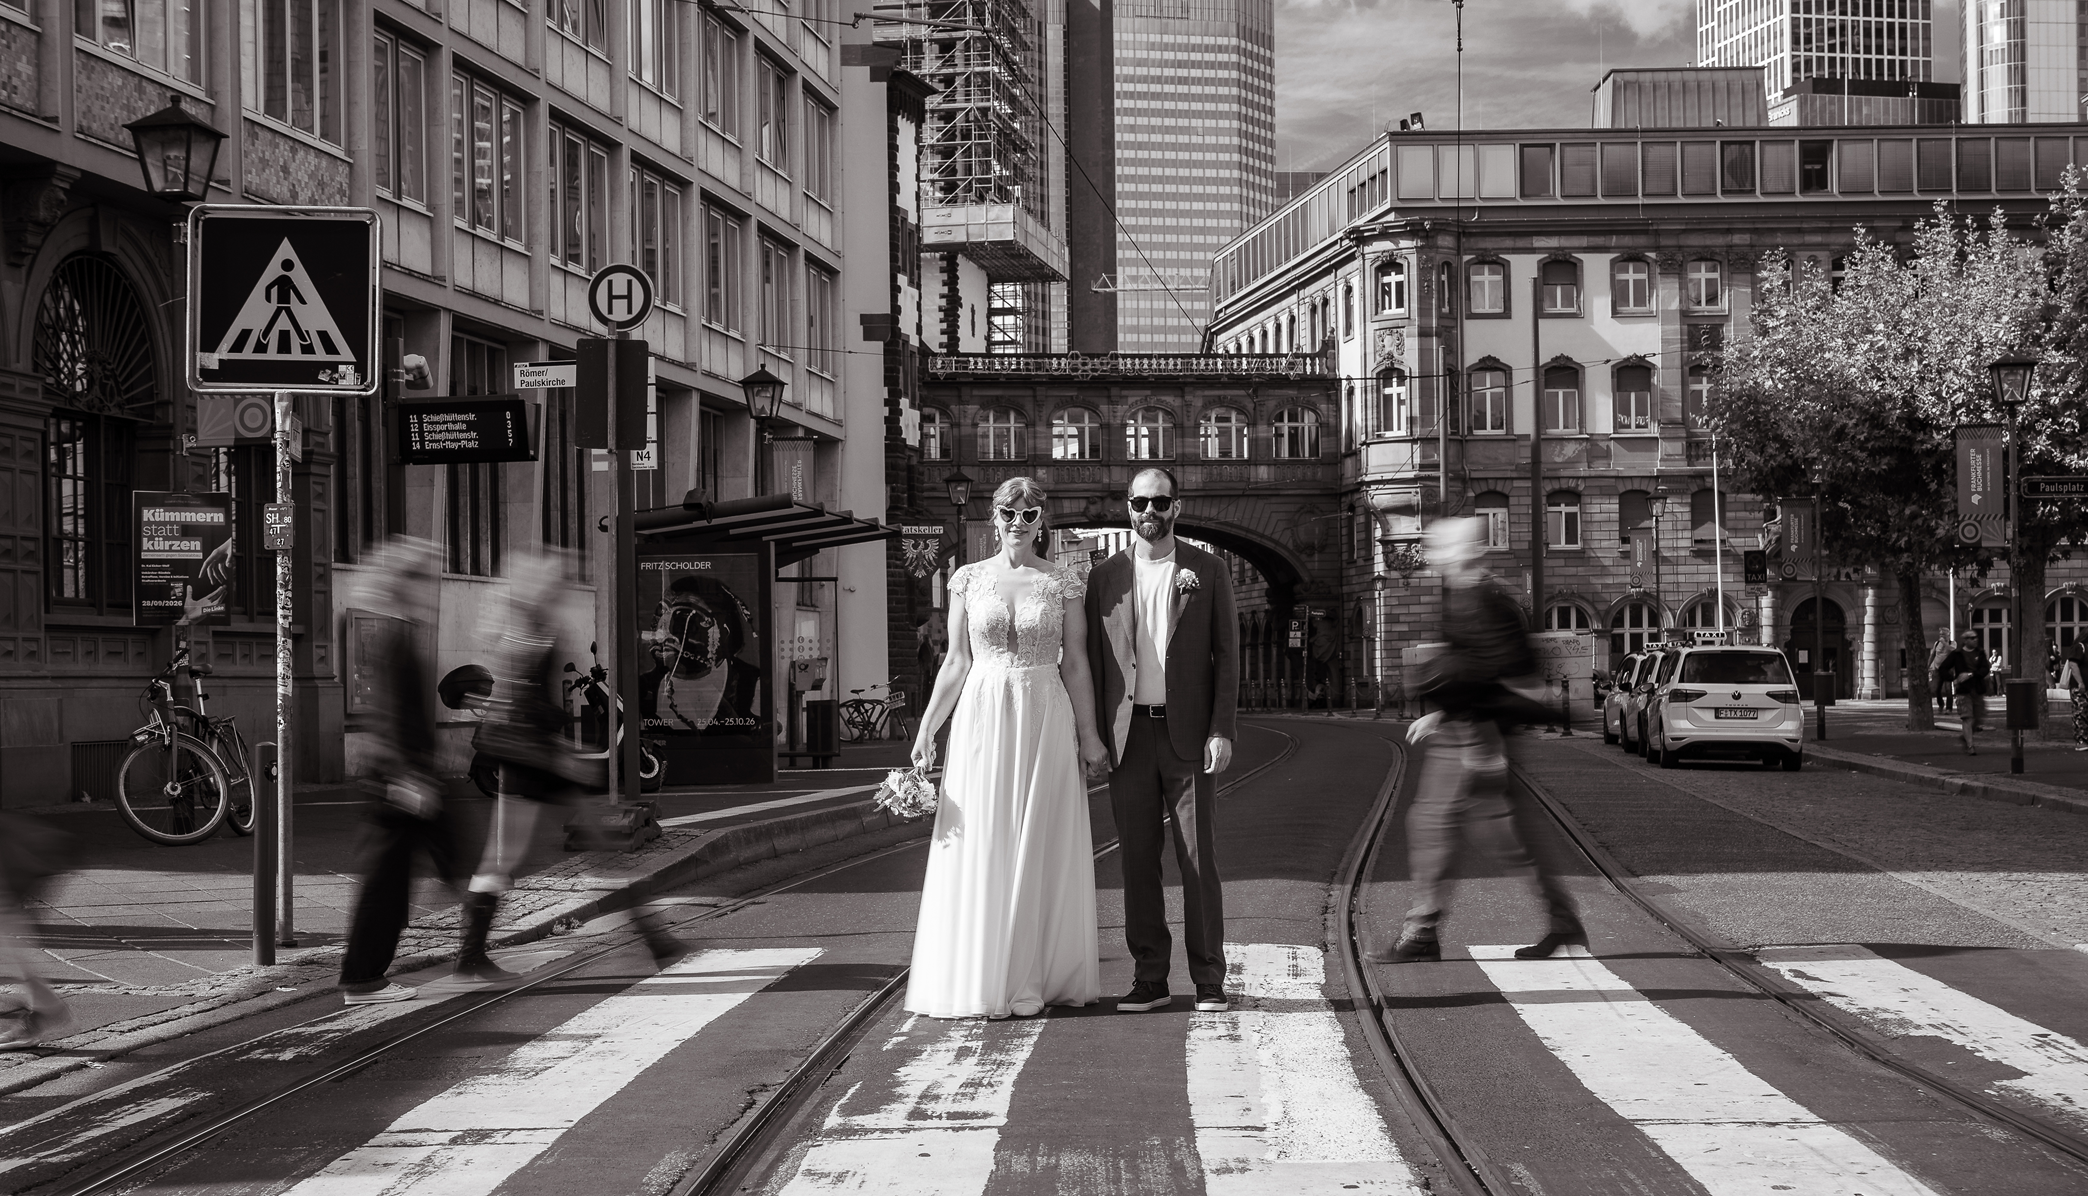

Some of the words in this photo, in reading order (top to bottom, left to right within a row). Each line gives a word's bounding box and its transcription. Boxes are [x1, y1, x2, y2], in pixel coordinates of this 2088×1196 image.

[608, 278, 635, 315] H
[520, 368, 549, 378] Römer/
[520, 378, 566, 388] Paulskirche
[409, 414, 418, 423] 11
[505, 411, 511, 419] 0
[410, 423, 419, 432] 12
[423, 422, 467, 433] Eissporthalle
[506, 420, 512, 429] 3
[411, 432, 420, 441] 11
[507, 429, 513, 438] 5
[412, 441, 421, 450] 14
[425, 440, 479, 450] Ernst-May-Platz
[508, 438, 514, 447] 7
[636, 451, 652, 461] N4
[2040, 482, 2085, 494] Paulsplatz
[143, 509, 224, 522] Kümmern
[266, 513, 279, 524] SH
[143, 524, 180, 536] statt
[902, 526, 943, 534] atskeller
[143, 537, 201, 551] kürzen
[640, 562, 664, 570] FRITZ
[665, 562, 712, 570] SCHOLDER
[1746, 573, 1766, 581] TAXI
[1292, 621, 1299, 630] P
[643, 718, 674, 726] TOWER
